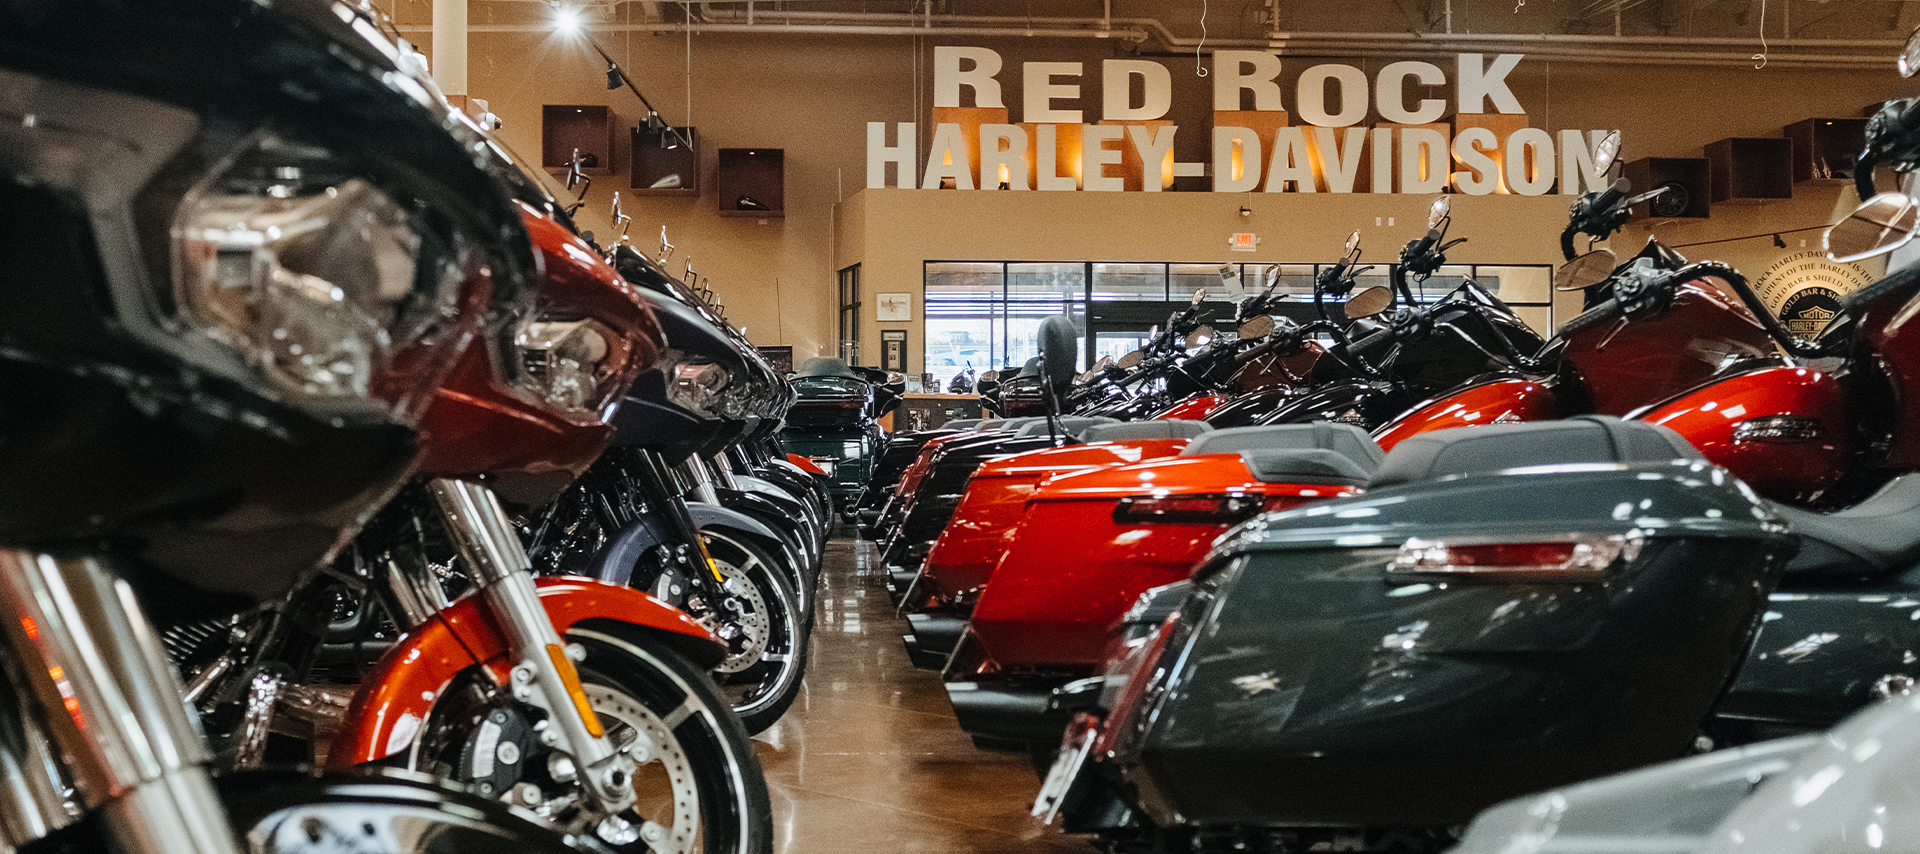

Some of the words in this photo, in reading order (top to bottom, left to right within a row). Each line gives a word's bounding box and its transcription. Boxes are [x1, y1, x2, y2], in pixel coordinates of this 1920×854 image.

[934, 45, 1172, 124] RED
[1213, 49, 1526, 128] ROCK
[866, 121, 1609, 197] HARLEY-DAVIDSON
[1236, 233, 1252, 247] EXIT
[1754, 270, 1772, 291] ROCK
[1851, 263, 1861, 272] IS
[1761, 272, 1786, 300] CIPIENT
[1786, 267, 1798, 276] OF
[1798, 263, 1816, 272] THE
[1820, 263, 1864, 288] HARLEY-DA
[1770, 286, 1788, 309] GOLD
[1787, 276, 1804, 289] BAR
[1813, 274, 1843, 288] SHIELD
[1782, 293, 1801, 315] GOLD
[1800, 288, 1819, 298] BAR
[1820, 288, 1826, 296] &
[1803, 308, 1830, 319] MOTOR
